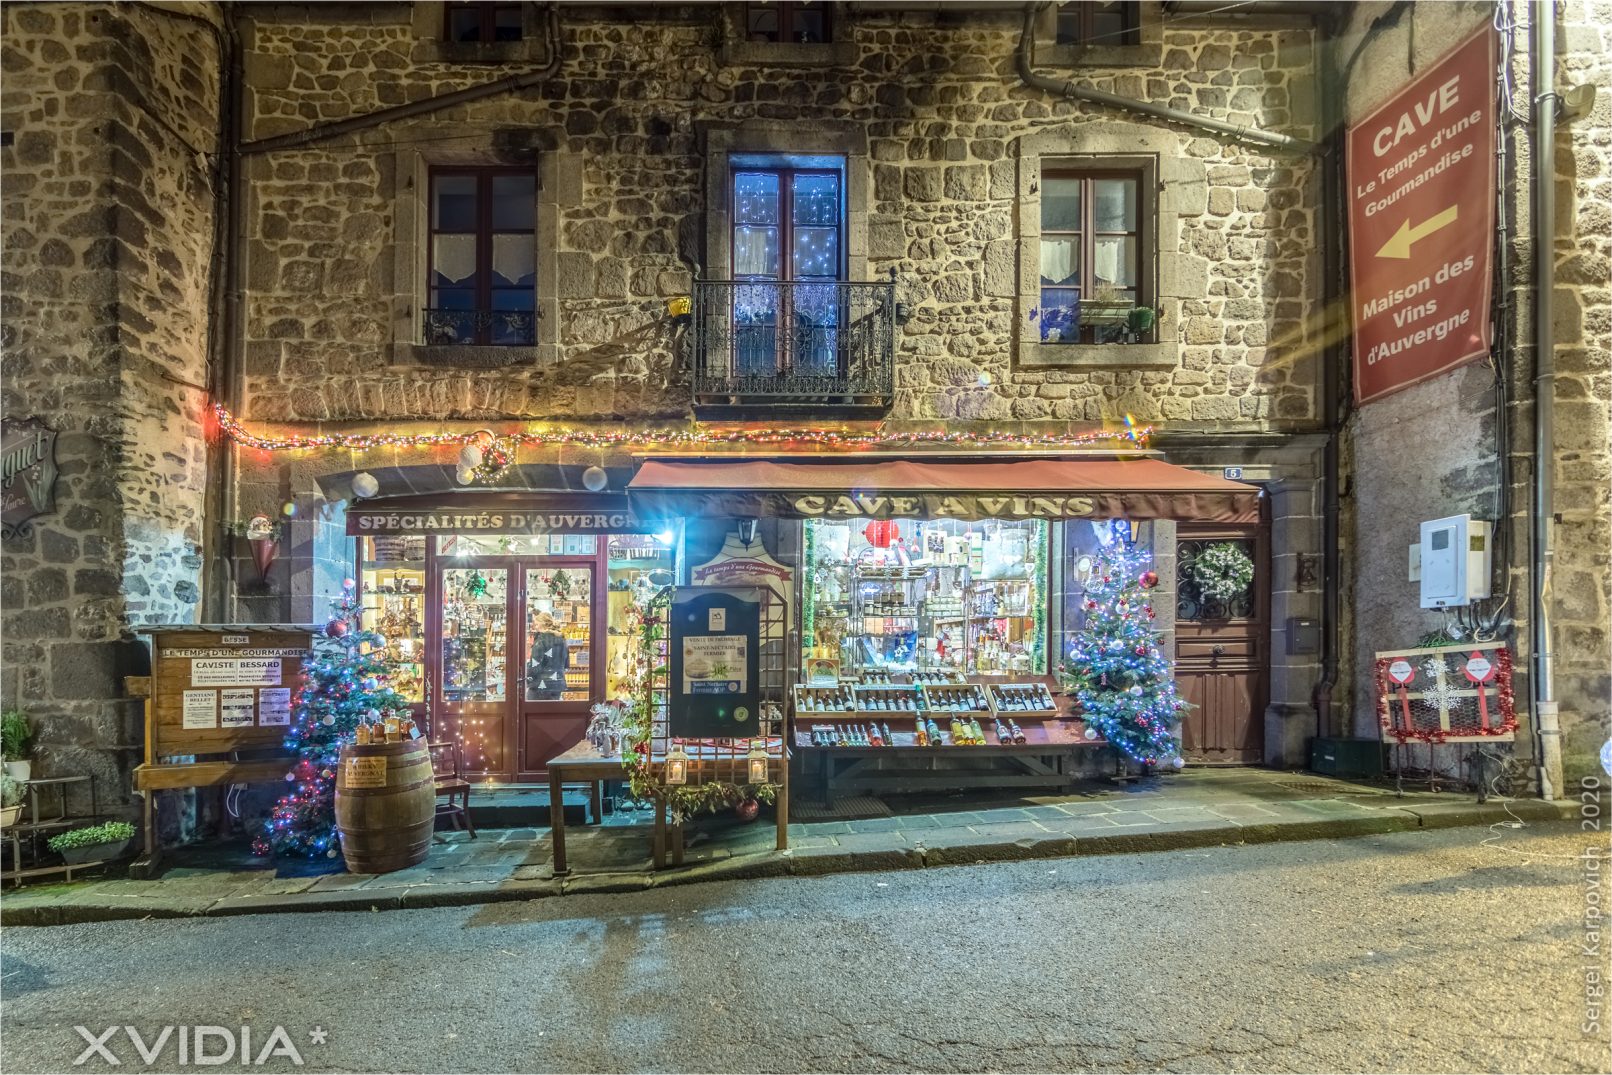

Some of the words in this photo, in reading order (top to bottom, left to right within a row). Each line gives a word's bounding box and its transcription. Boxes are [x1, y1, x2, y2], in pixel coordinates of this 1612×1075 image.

[1373, 75, 1460, 157] CAVE
[1357, 178, 1376, 199] Le
[1378, 147, 1427, 183] Temps
[1430, 109, 1482, 147] d'une
[1364, 142, 1473, 217] Gourmandise
[1362, 275, 1431, 320] Maison
[1435, 253, 1474, 284] des
[1393, 297, 1437, 329] Vins
[1367, 306, 1470, 366] d'Auvergne
[1230, 470, 1237, 478] 5
[358, 511, 503, 529] SPÉCIALITÉS
[795, 496, 920, 515] CAVE
[932, 497, 969, 515] A
[975, 496, 1095, 516] VINS
